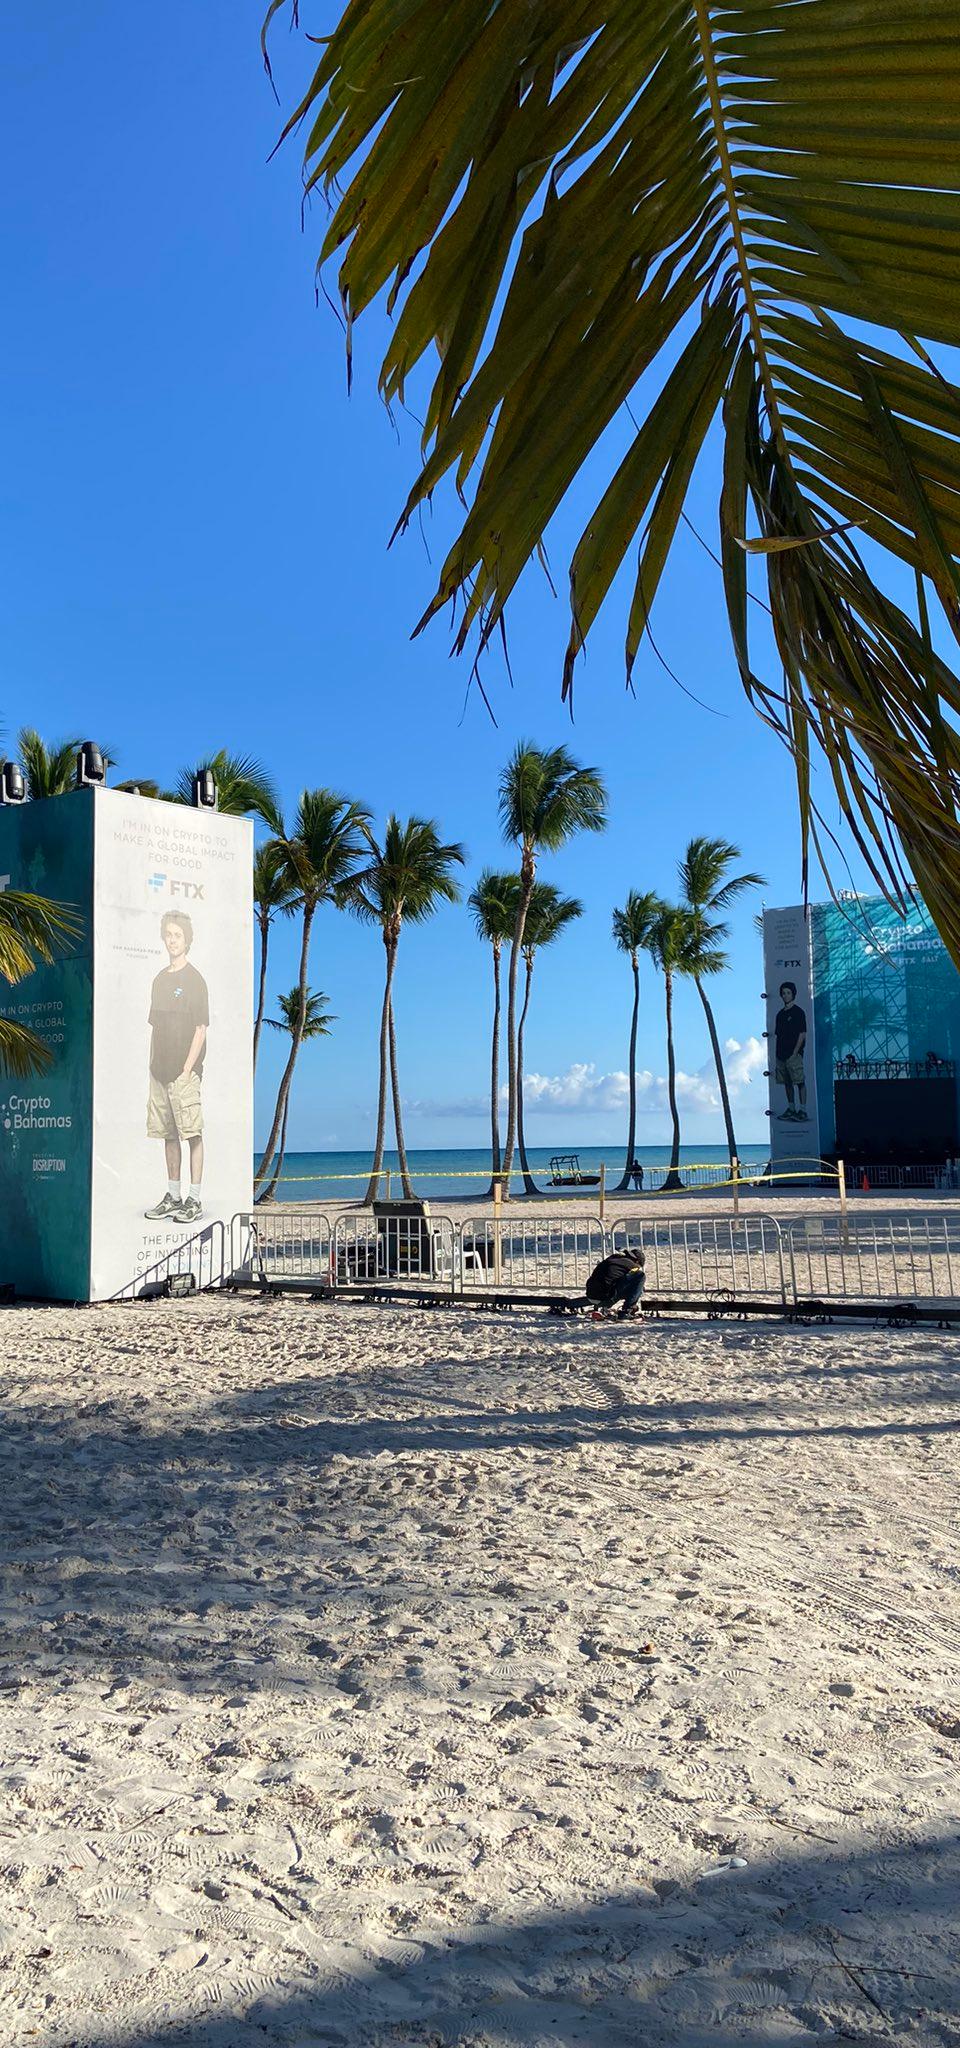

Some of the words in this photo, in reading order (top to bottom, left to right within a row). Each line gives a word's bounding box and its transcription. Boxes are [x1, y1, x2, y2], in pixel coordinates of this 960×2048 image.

[122, 818, 137, 831] I'M
[140, 823, 151, 832] IN
[154, 825, 170, 837] ON
[173, 829, 212, 845] CRYPTO
[215, 836, 228, 847] TO
[113, 832, 144, 846] MAKE
[147, 839, 154, 848] A
[157, 839, 198, 856] GLOBAL
[201, 848, 235, 862] IMPACT
[148, 852, 169, 864] FOR
[172, 857, 202, 869] GOOD
[170, 880, 205, 900] FTX
[877, 938, 944, 953] Bahama
[784, 960, 802, 968] FTX
[8, 1006, 16, 1015] IN
[18, 1005, 30, 1014] ON
[32, 1001, 63, 1013] CRYPTO
[35, 1017, 66, 1028] GLOBAL
[40, 1033, 64, 1043] GOOD
[9, 1095, 51, 1113] Crypto
[14, 1113, 72, 1128] Bahamas
[142, 1235, 162, 1245] THE
[137, 1251, 151, 1261] OF
[155, 1246, 209, 1259] INVESTING
[133, 1266, 143, 1275] IS
